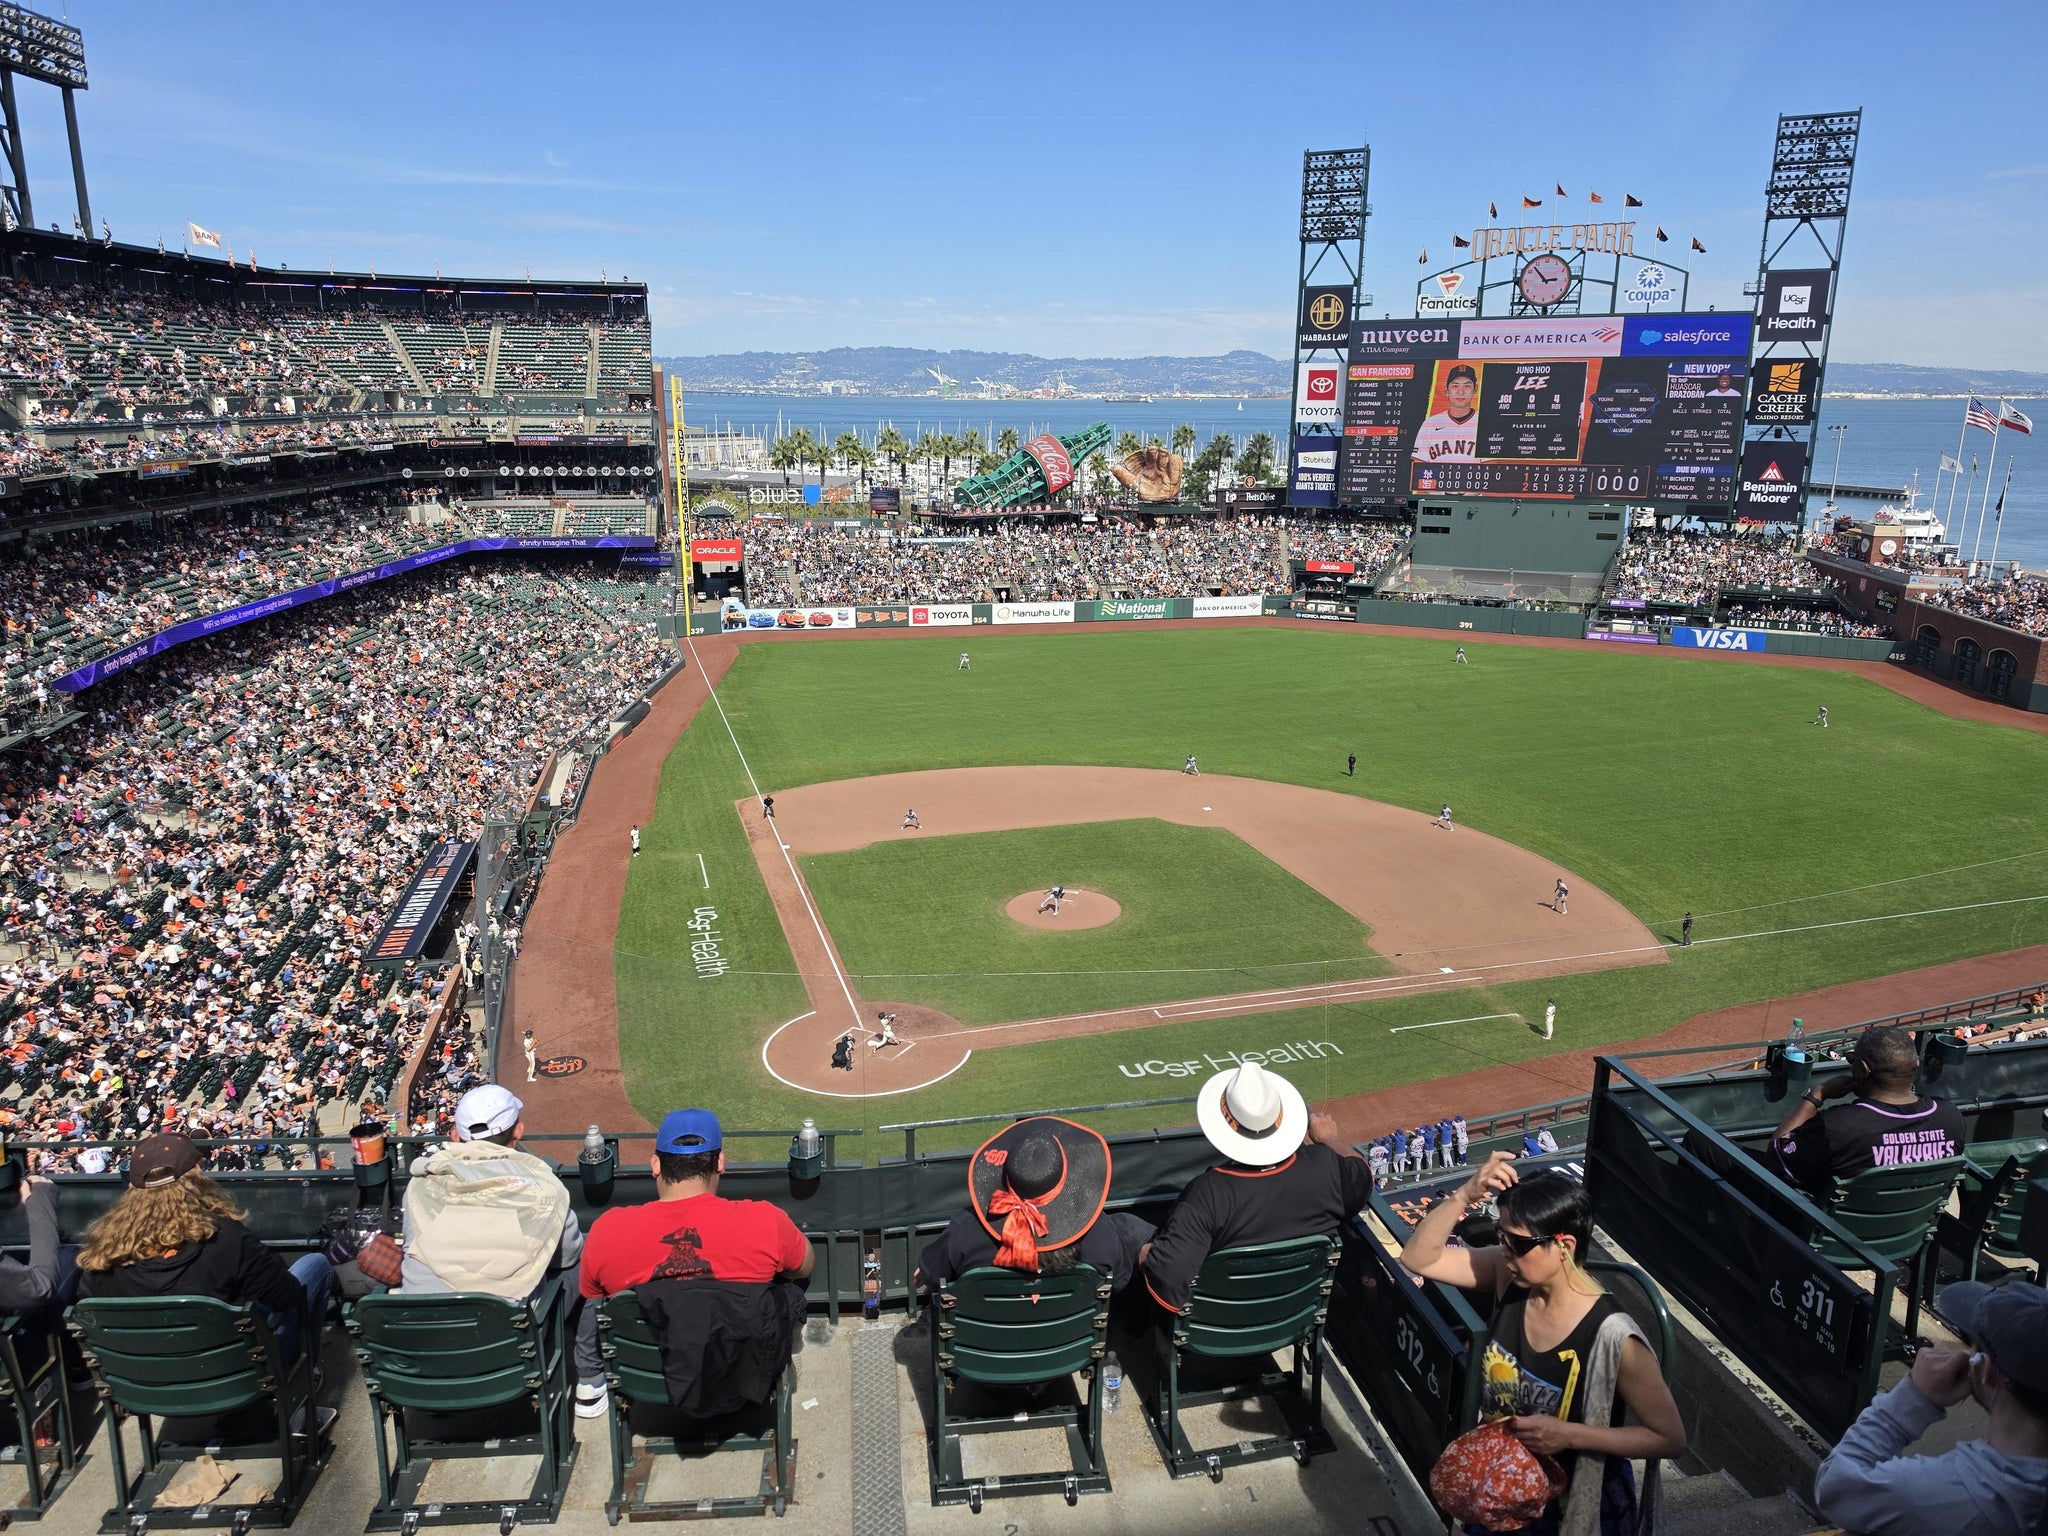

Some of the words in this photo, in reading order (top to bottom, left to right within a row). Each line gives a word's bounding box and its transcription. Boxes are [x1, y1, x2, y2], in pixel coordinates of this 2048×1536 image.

[1472, 225, 1563, 262] ORACLE
[1570, 222, 1636, 257] PARK
[1628, 289, 1670, 304] coupa
[1784, 294, 1806, 305] UCSF
[1419, 296, 1478, 310] Fanatics
[1768, 317, 1816, 329] Health
[1302, 334, 1331, 342] HABBAS
[1361, 328, 1448, 344] nuveen
[1464, 336, 1500, 345] BANK
[1504, 335, 1520, 344] OF
[1524, 334, 1588, 344] AMERICA
[1664, 330, 1730, 344] salesforce
[1352, 368, 1367, 376] SAN
[1368, 367, 1410, 376] FRANCISCO
[1684, 364, 1705, 373] NEW
[1514, 376, 1550, 390] LEE
[1529, 394, 1535, 403] 0
[1554, 394, 1560, 403] 4
[1758, 394, 1807, 404] CACHE
[1299, 408, 1341, 416] TOYOTA
[1758, 404, 1804, 413] CREEK
[1303, 456, 1332, 464] StubHub
[1312, 473, 1335, 481] VERIFIED
[1524, 473, 1529, 481] 1
[1559, 474, 1564, 482] 6
[1569, 474, 1575, 482] 3
[1296, 482, 1314, 491] GIANTS
[1315, 482, 1335, 491] TICKETS
[1523, 483, 1528, 491] 2
[1533, 483, 1538, 491] 5
[1558, 484, 1564, 492] 3
[1568, 484, 1574, 492] 2
[1597, 476, 1607, 490] 0
[1613, 476, 1623, 491] 0
[1628, 476, 1638, 492] 0
[1743, 482, 1797, 494] Benjamin
[750, 485, 800, 504] blue
[1738, 516, 1767, 527] Coors
[519, 540, 541, 548] xfinity
[367, 571, 375, 580] That
[1012, 608, 1050, 619] Hanwha
[1053, 607, 1070, 617] Life
[1116, 602, 1166, 615] National
[932, 610, 969, 620] TOYOTA
[1730, 620, 1771, 629] WELCOME
[1691, 629, 1748, 650] VISA
[138, 645, 148, 658] That
[376, 928, 414, 957] GIANTS
[690, 931, 734, 978] Health
[1118, 1060, 1203, 1078] UCSF
[1203, 1040, 1344, 1071] Health
[1882, 1132, 1917, 1144] GOLDEN
[1919, 1129, 1945, 1141] STATE
[1802, 1280, 1834, 1326] 311
[1397, 1317, 1424, 1376] 312
